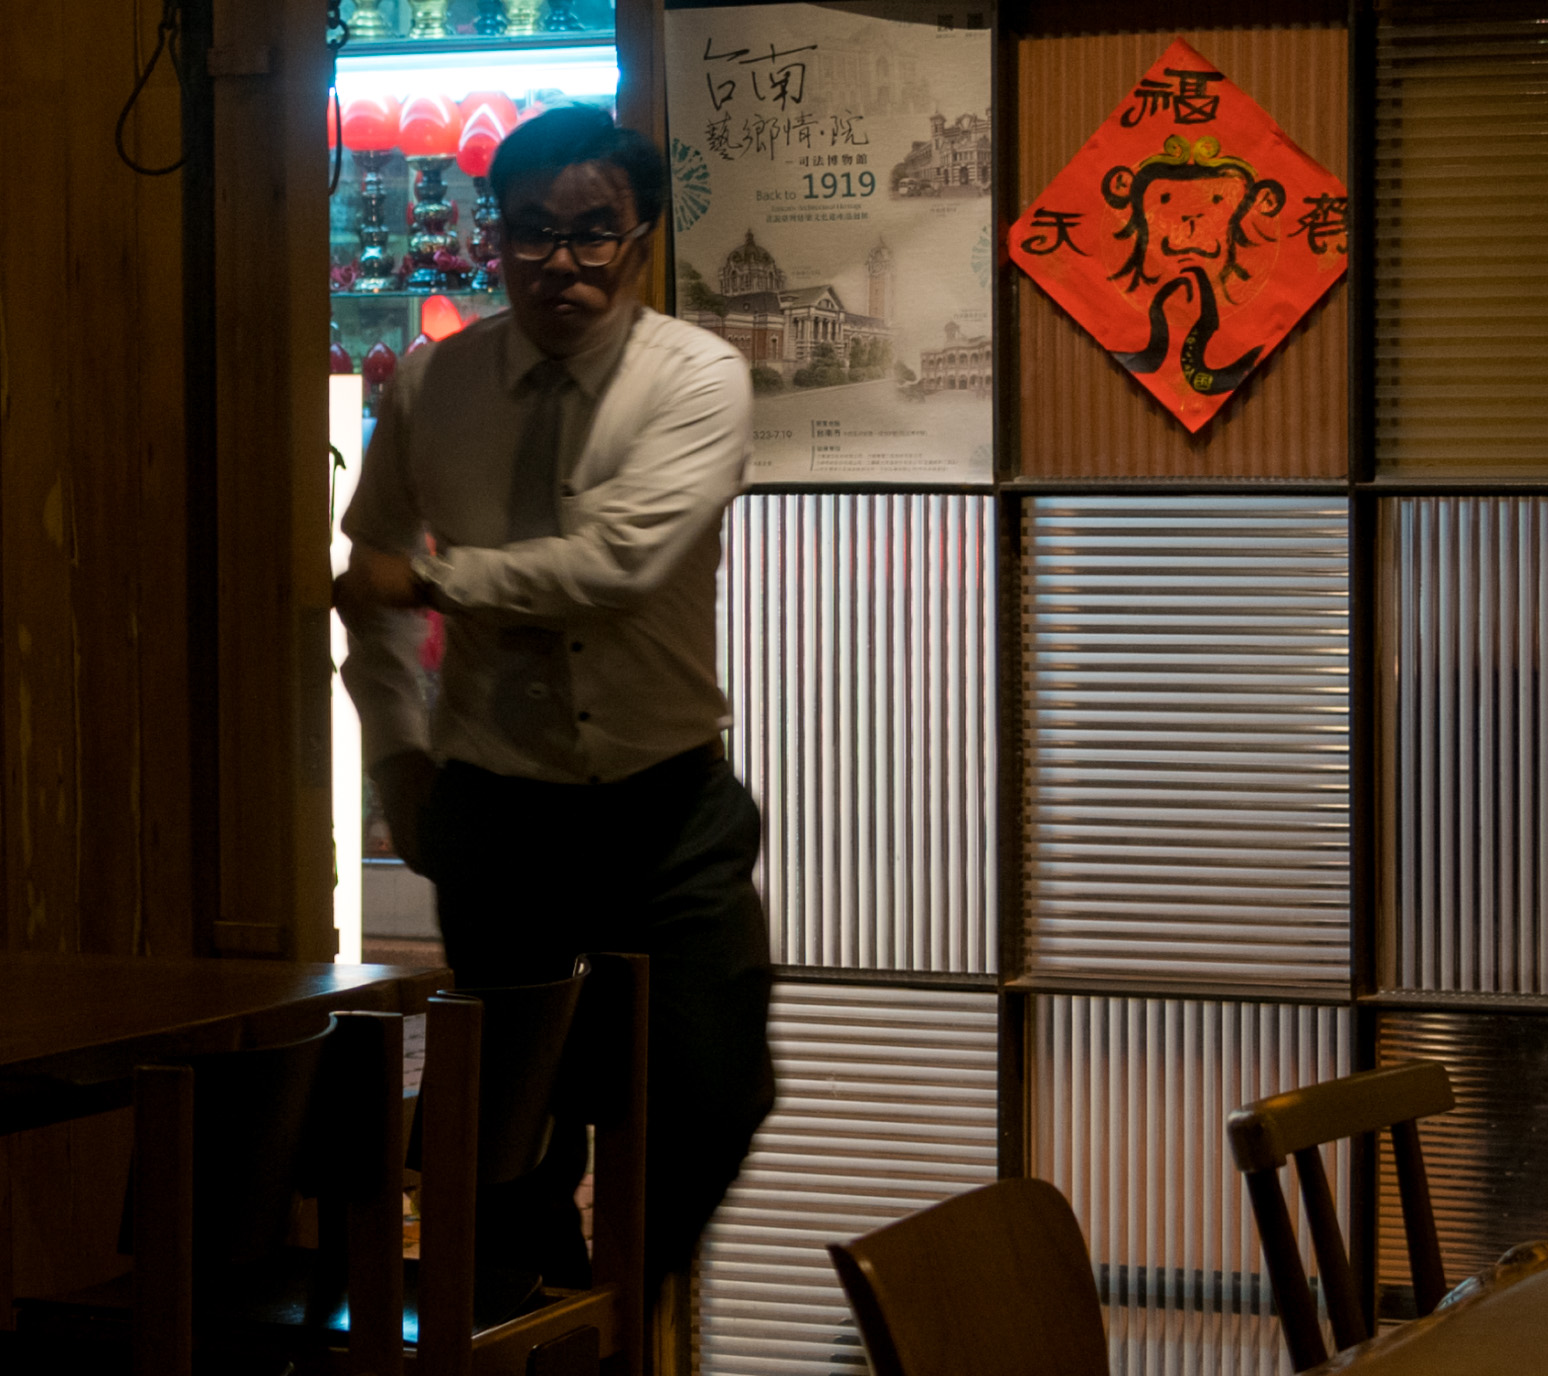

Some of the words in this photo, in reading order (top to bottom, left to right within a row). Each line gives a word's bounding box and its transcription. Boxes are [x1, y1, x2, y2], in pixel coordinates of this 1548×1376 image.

[703, 37, 819, 112] 台南
[1120, 67, 1226, 129] 福
[756, 188, 782, 202] Back
[784, 189, 797, 201] to
[803, 171, 877, 200] 1919
